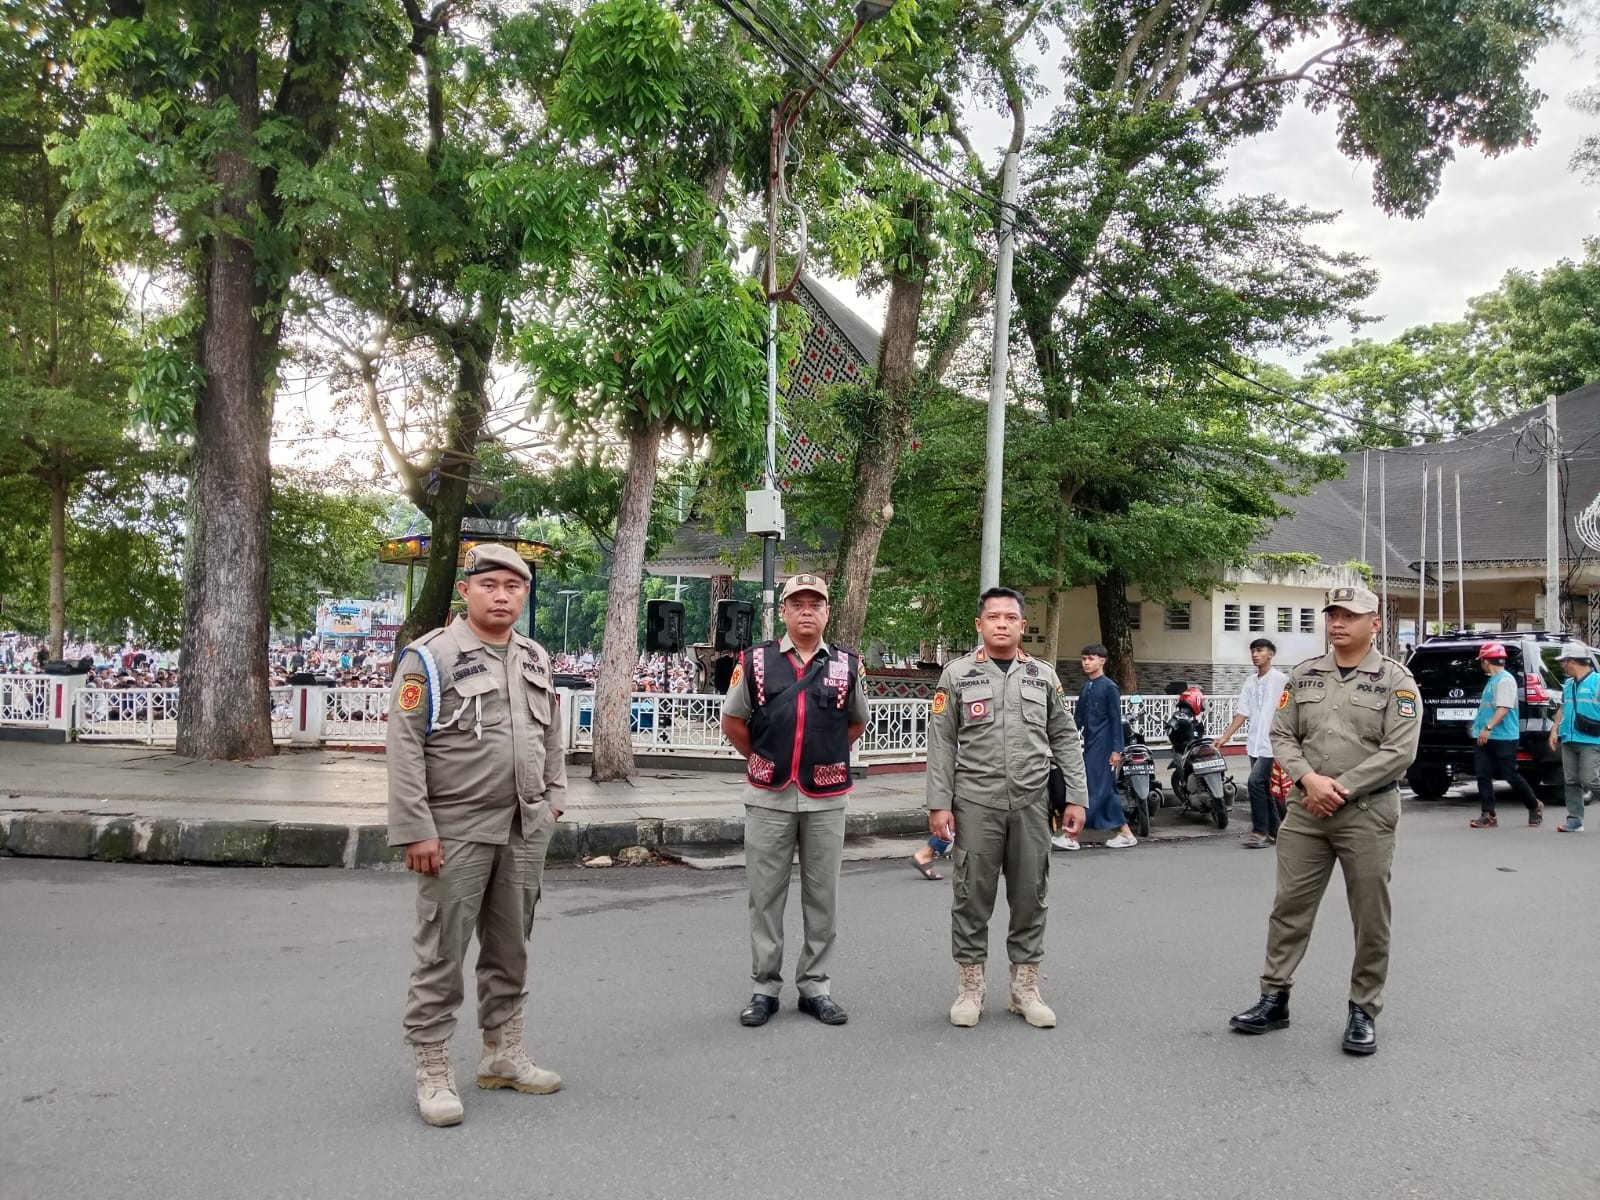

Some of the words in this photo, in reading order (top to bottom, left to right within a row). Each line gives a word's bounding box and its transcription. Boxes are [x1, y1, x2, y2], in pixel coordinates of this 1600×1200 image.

[823, 677, 837, 686] POL
[838, 679, 848, 687] PP
[1021, 679, 1035, 687] POL
[1298, 680, 1325, 689] SITIO
[1356, 683, 1373, 692] POL
